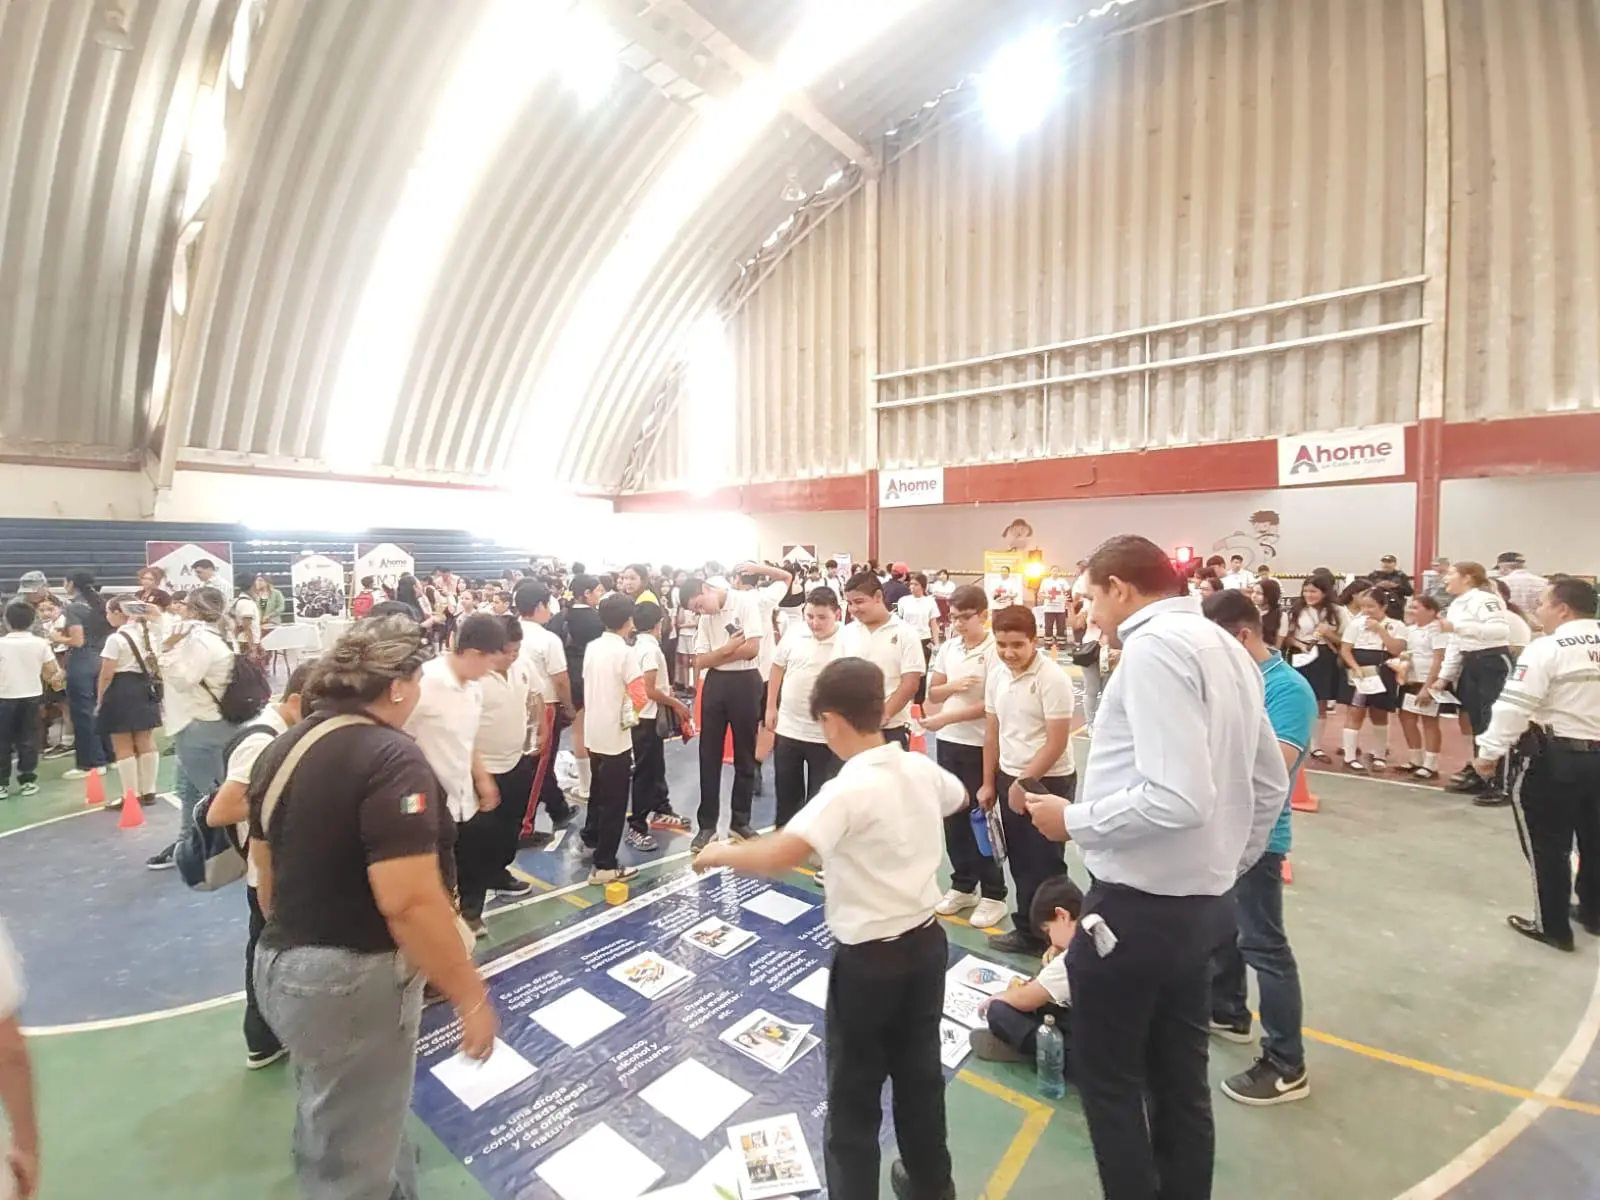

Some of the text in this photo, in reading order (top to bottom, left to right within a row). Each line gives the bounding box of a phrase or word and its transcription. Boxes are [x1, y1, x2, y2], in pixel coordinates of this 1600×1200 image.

[1289, 442, 1392, 474] Ahome
[885, 478, 937, 500] Ahome
[379, 558, 407, 568] Ahome
[508, 975, 563, 1004] considerada
[513, 983, 531, 994] una
[532, 970, 559, 985] droga
[608, 1039, 648, 1063] Tabaco,
[616, 1042, 658, 1072] alcohol y
[490, 1086, 567, 1136] Es una droga
[482, 1104, 557, 1154] considerada
[510, 1102, 578, 1151] y de origen
